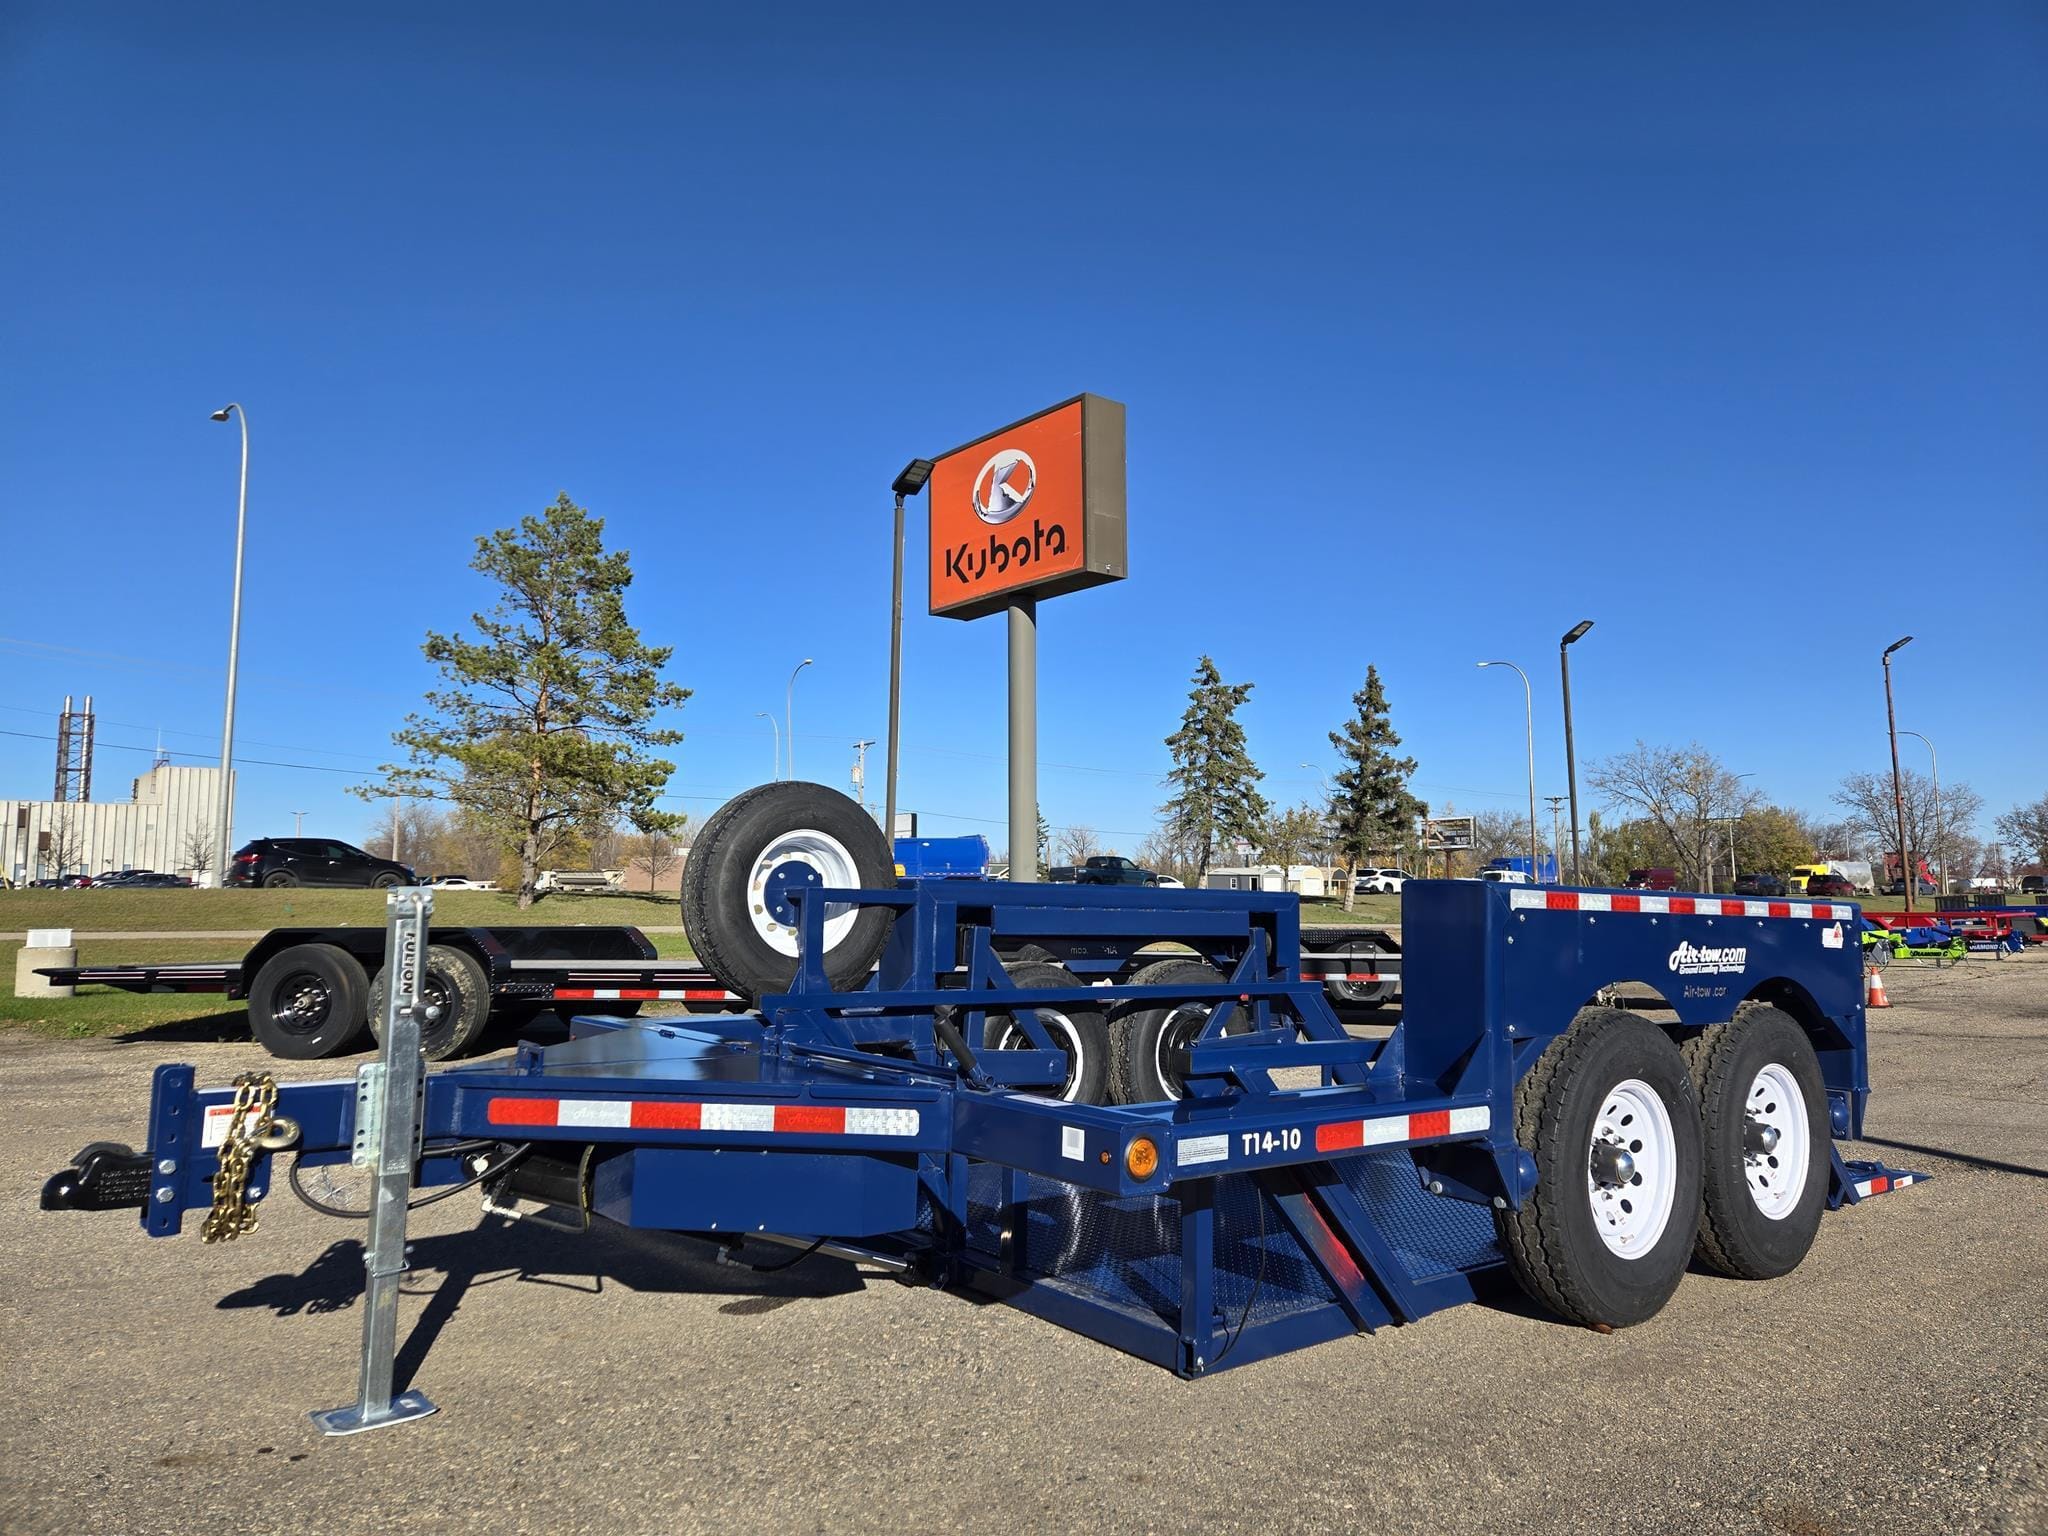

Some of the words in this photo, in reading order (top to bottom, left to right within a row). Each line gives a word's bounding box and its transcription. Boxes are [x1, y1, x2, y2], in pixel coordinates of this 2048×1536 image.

[946, 519, 1066, 583] Kubota
[400, 931, 416, 995] FULTON
[1242, 1128, 1301, 1155] T14-10
